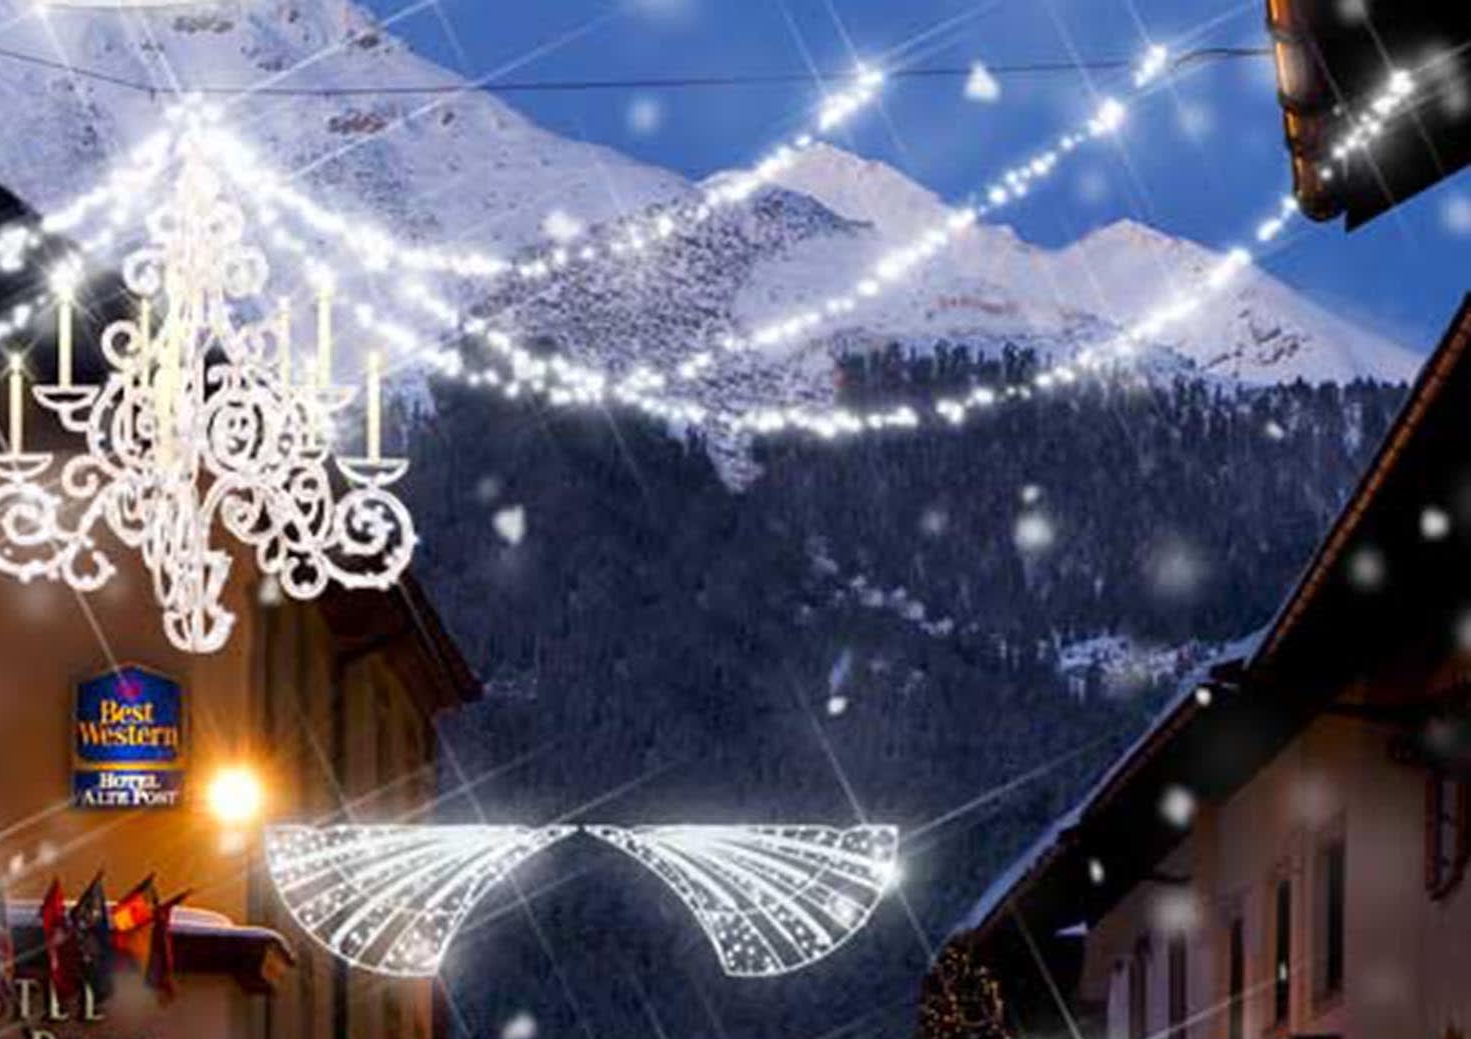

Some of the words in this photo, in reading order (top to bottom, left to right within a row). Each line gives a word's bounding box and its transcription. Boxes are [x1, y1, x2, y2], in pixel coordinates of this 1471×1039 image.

[100, 699, 154, 723] Best
[80, 722, 178, 746] Western
[98, 772, 161, 789] HOTEL
[82, 789, 129, 806] ALTE
[132, 788, 179, 806] POST
